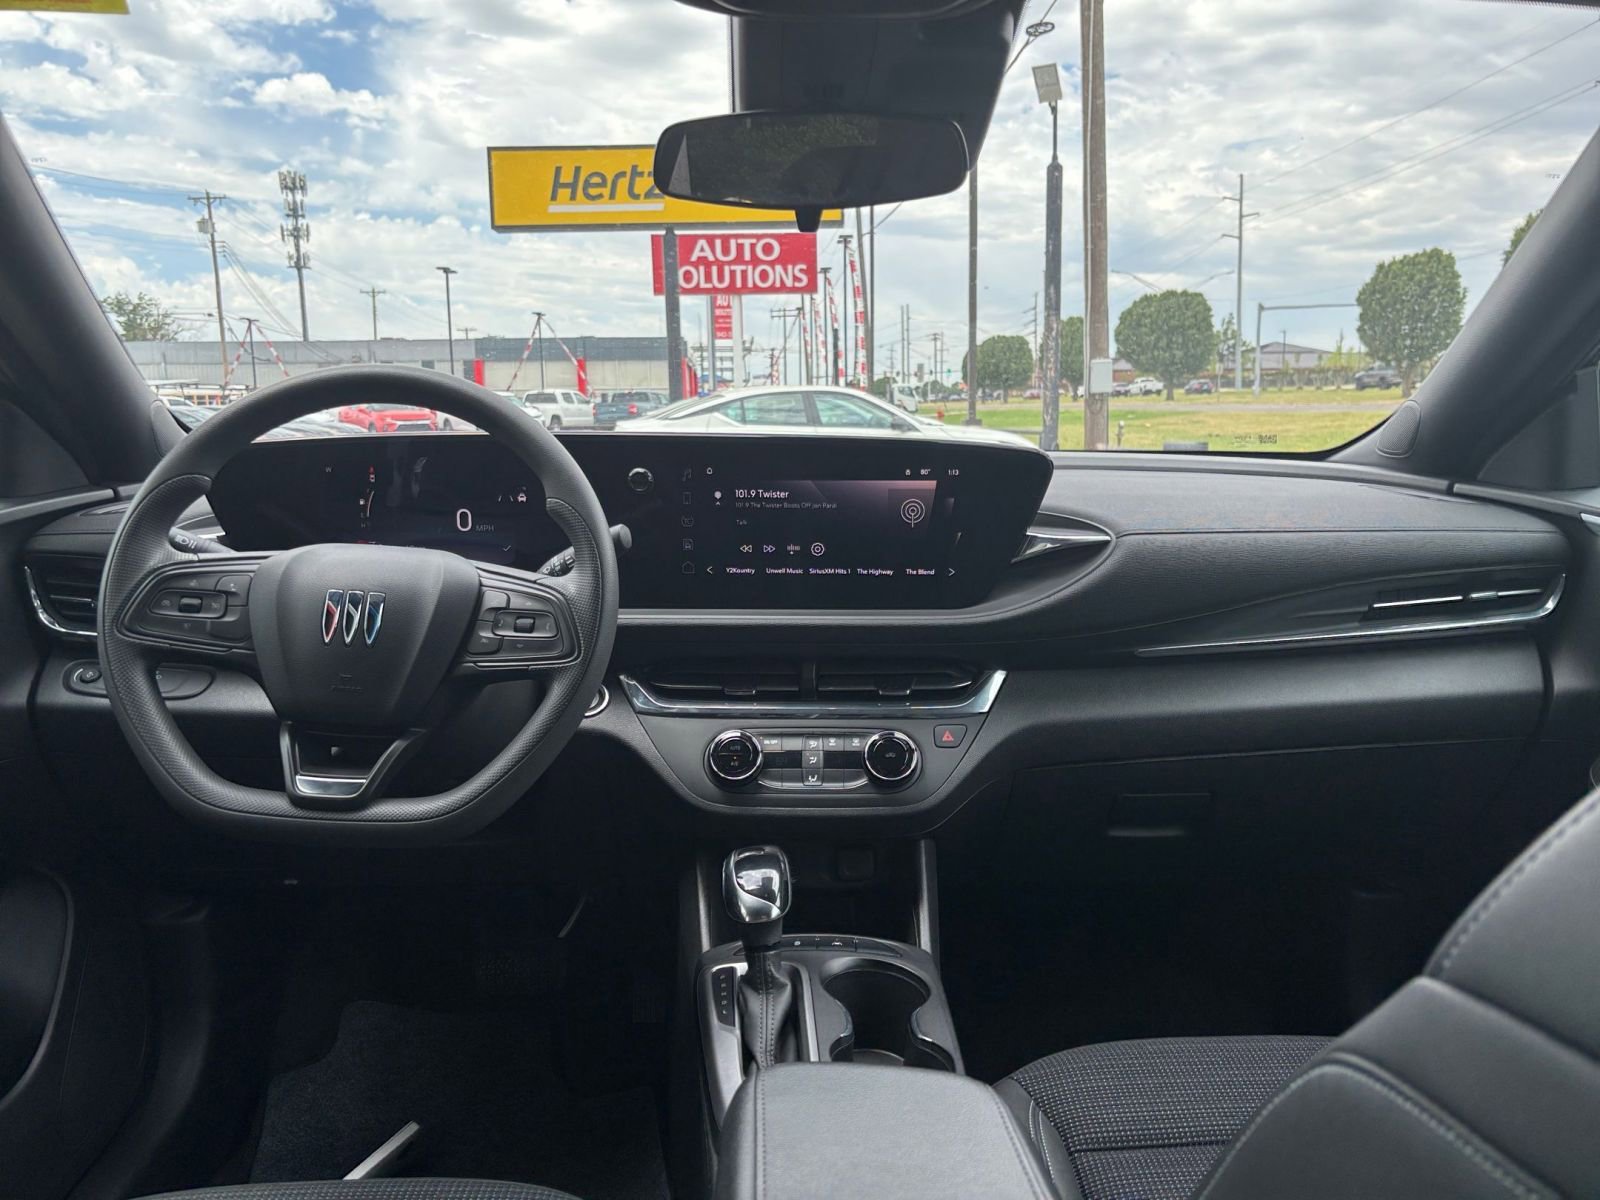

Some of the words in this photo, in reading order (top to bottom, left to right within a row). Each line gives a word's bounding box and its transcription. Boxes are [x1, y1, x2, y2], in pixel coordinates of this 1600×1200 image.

[690, 238, 781, 261] AUTO
[677, 264, 809, 289] OLUTIONS
[948, 468, 959, 476] 1:13
[735, 489, 756, 498] 101.9
[757, 489, 789, 498] Twister
[456, 508, 472, 532] 0
[725, 567, 755, 575] Y2Kountry
[786, 567, 803, 575] Music
[808, 567, 834, 575] SiriusXM
[868, 568, 894, 576] Highway
